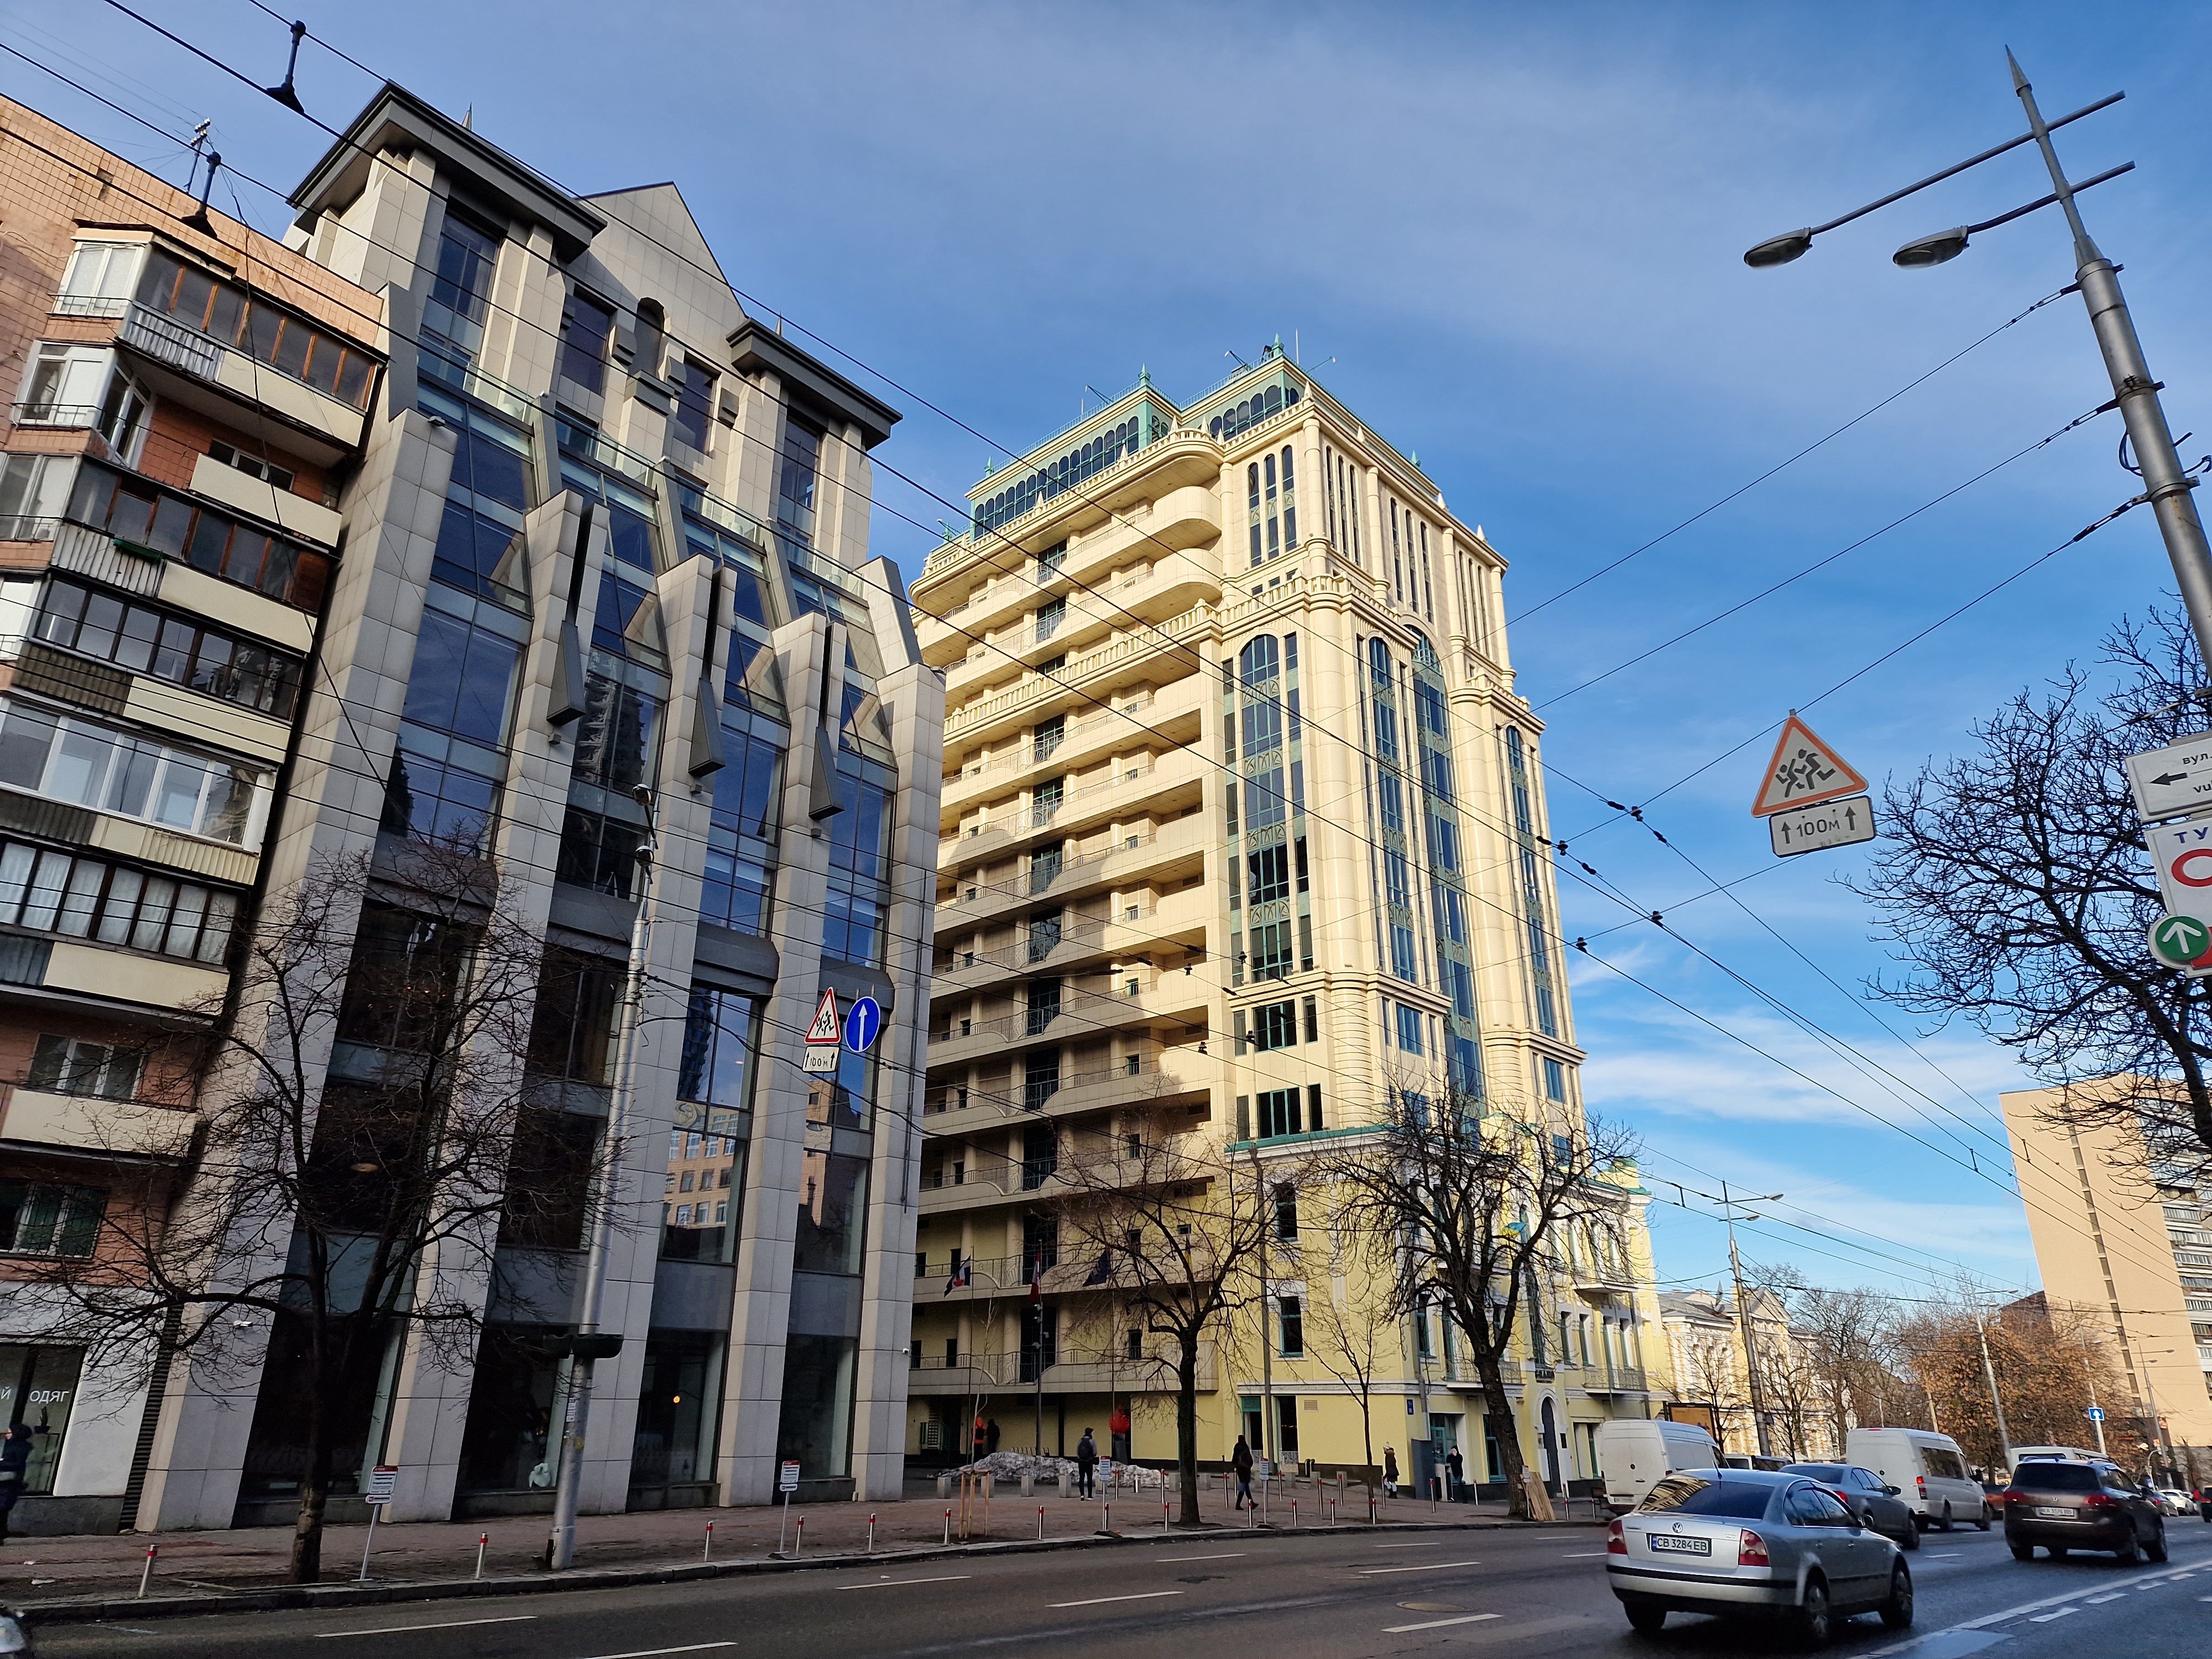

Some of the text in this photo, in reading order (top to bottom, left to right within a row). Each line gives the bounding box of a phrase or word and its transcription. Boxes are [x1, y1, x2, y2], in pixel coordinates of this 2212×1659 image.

[2193, 780, 2212, 793] vu
[29, 1390, 70, 1405] ОДЯГ
[1671, 1538, 1692, 1550] 3284
